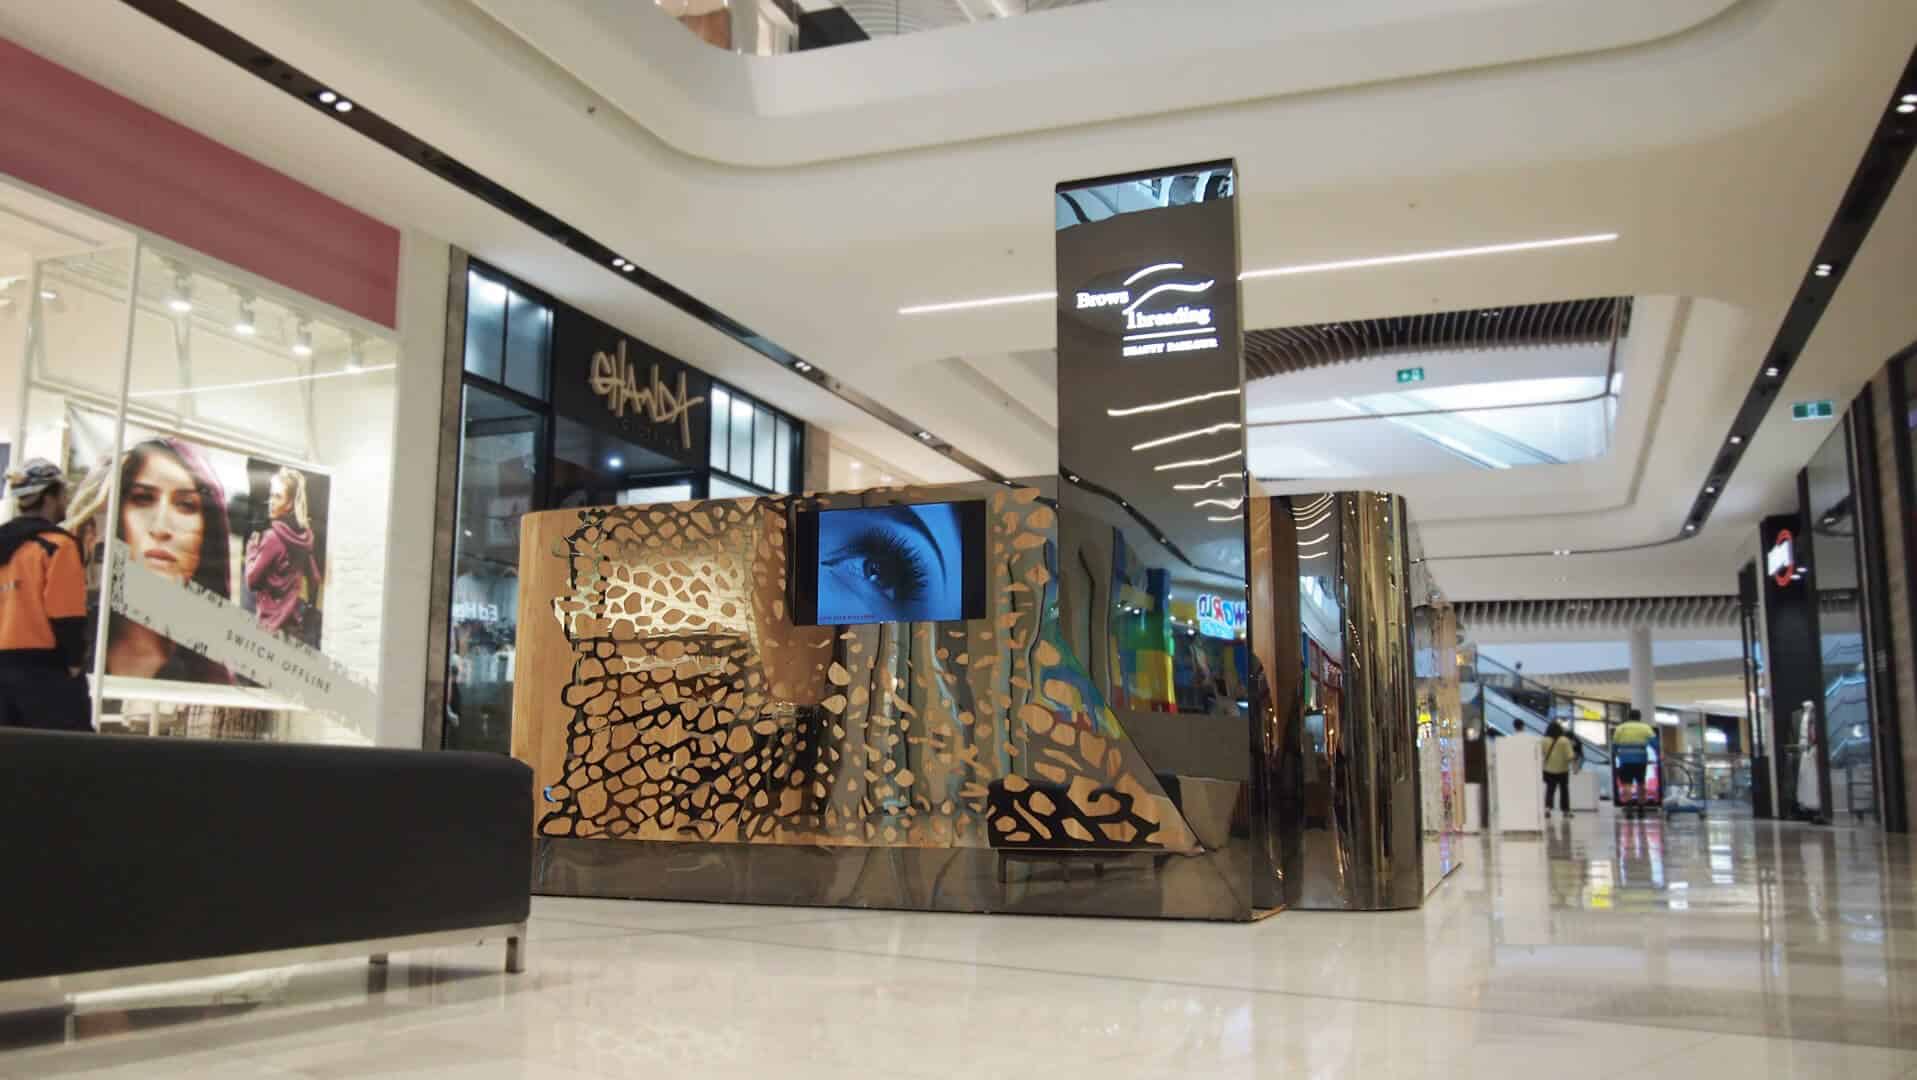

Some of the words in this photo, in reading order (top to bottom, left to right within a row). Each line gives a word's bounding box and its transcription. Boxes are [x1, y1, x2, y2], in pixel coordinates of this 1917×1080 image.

[1077, 291, 1129, 309] Brows
[226, 629, 275, 662] SWITCH
[281, 660, 332, 694] OFFLINE
